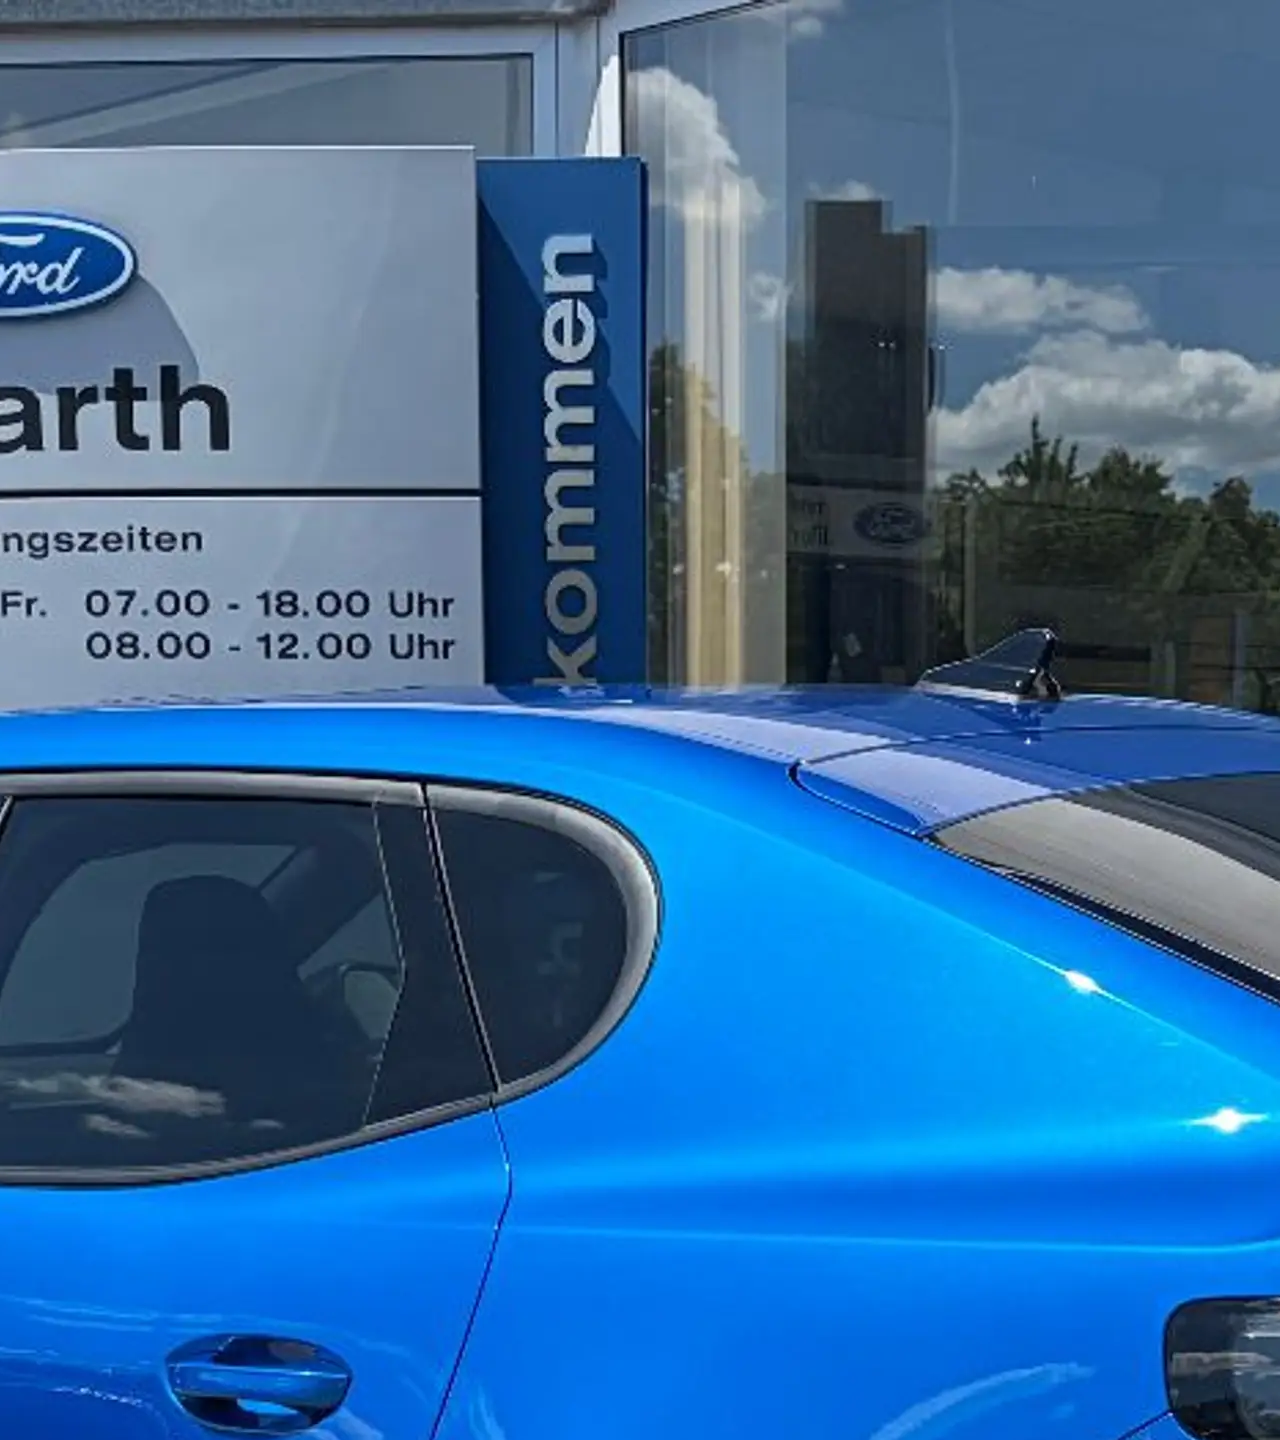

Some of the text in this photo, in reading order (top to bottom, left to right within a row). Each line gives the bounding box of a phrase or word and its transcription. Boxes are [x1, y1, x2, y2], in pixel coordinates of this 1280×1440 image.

[533, 233, 598, 686] kommen
[0, 589, 47, 618] Fr.
[84, 588, 211, 618] 07.00
[255, 589, 371, 619] 18.00
[388, 589, 455, 619] Uhr
[85, 631, 211, 660] 08.00
[256, 632, 373, 661] 12.00
[389, 632, 456, 660] Uhr
